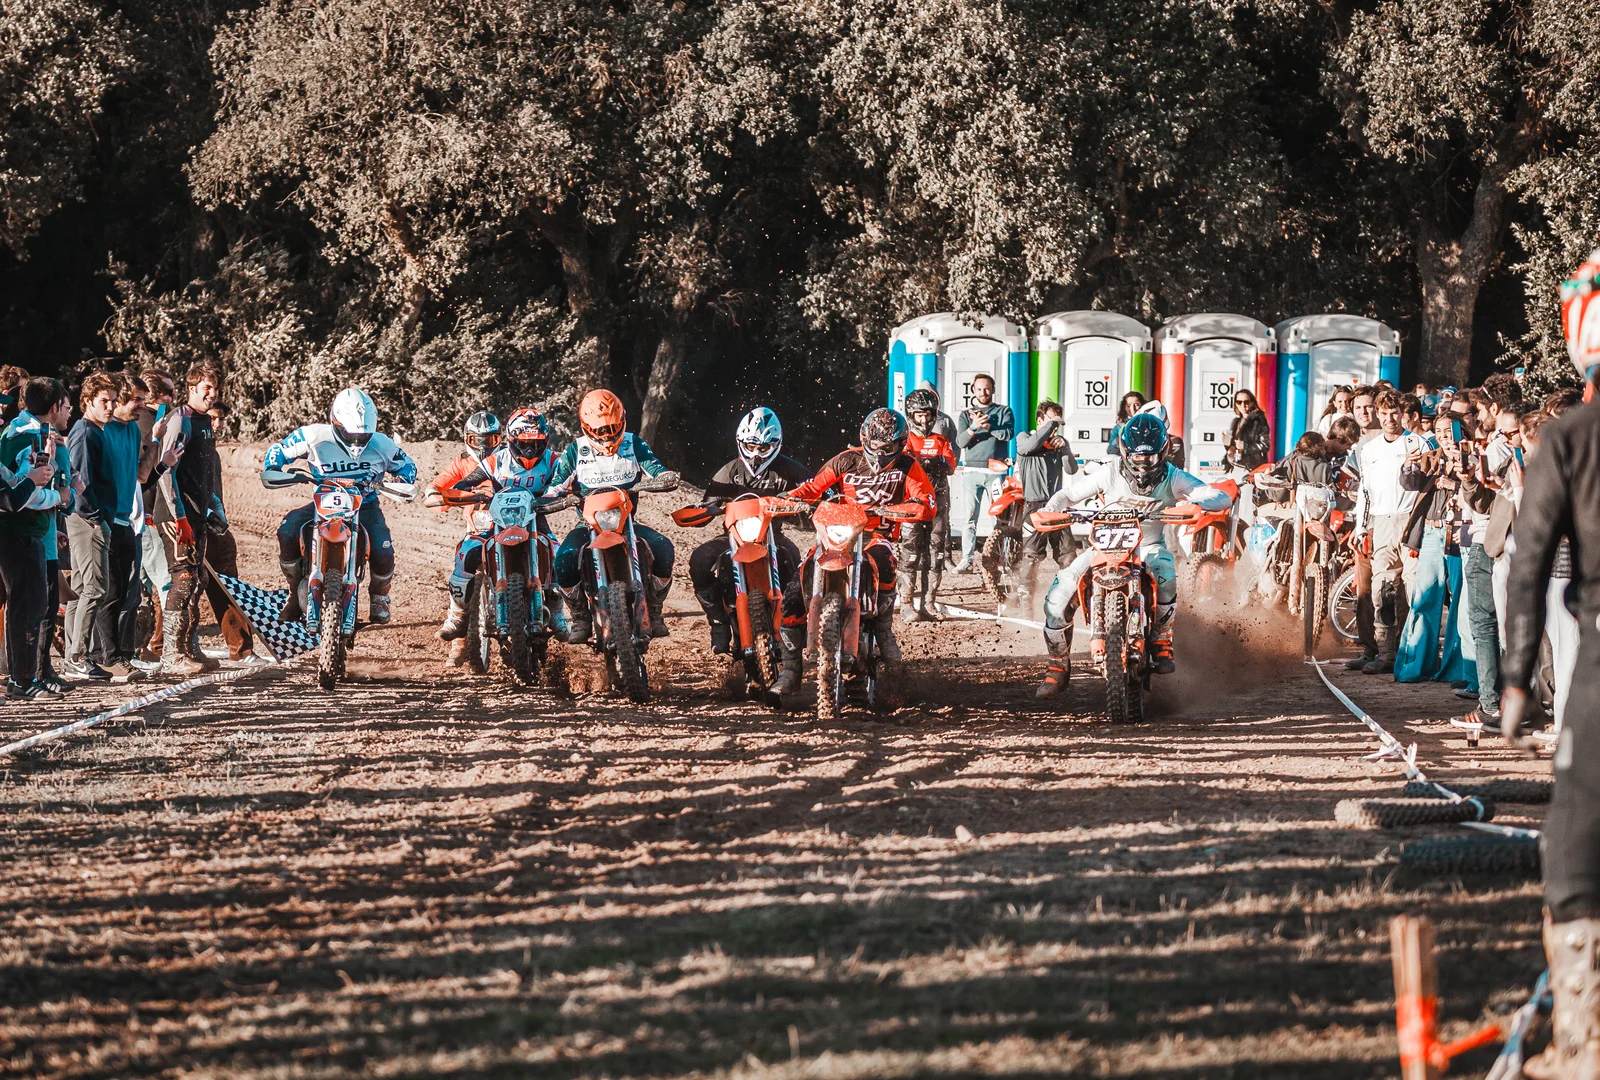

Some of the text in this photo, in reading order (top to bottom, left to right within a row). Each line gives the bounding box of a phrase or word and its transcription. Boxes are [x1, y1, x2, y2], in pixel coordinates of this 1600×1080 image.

[1085, 381, 1108, 394] TOI
[1210, 383, 1233, 395] TOI
[1085, 394, 1108, 407] TOI
[1210, 396, 1233, 409] TOI
[583, 471, 635, 485] CLOSASEGUROS
[333, 495, 342, 506] 5
[1094, 528, 1140, 550] 373
